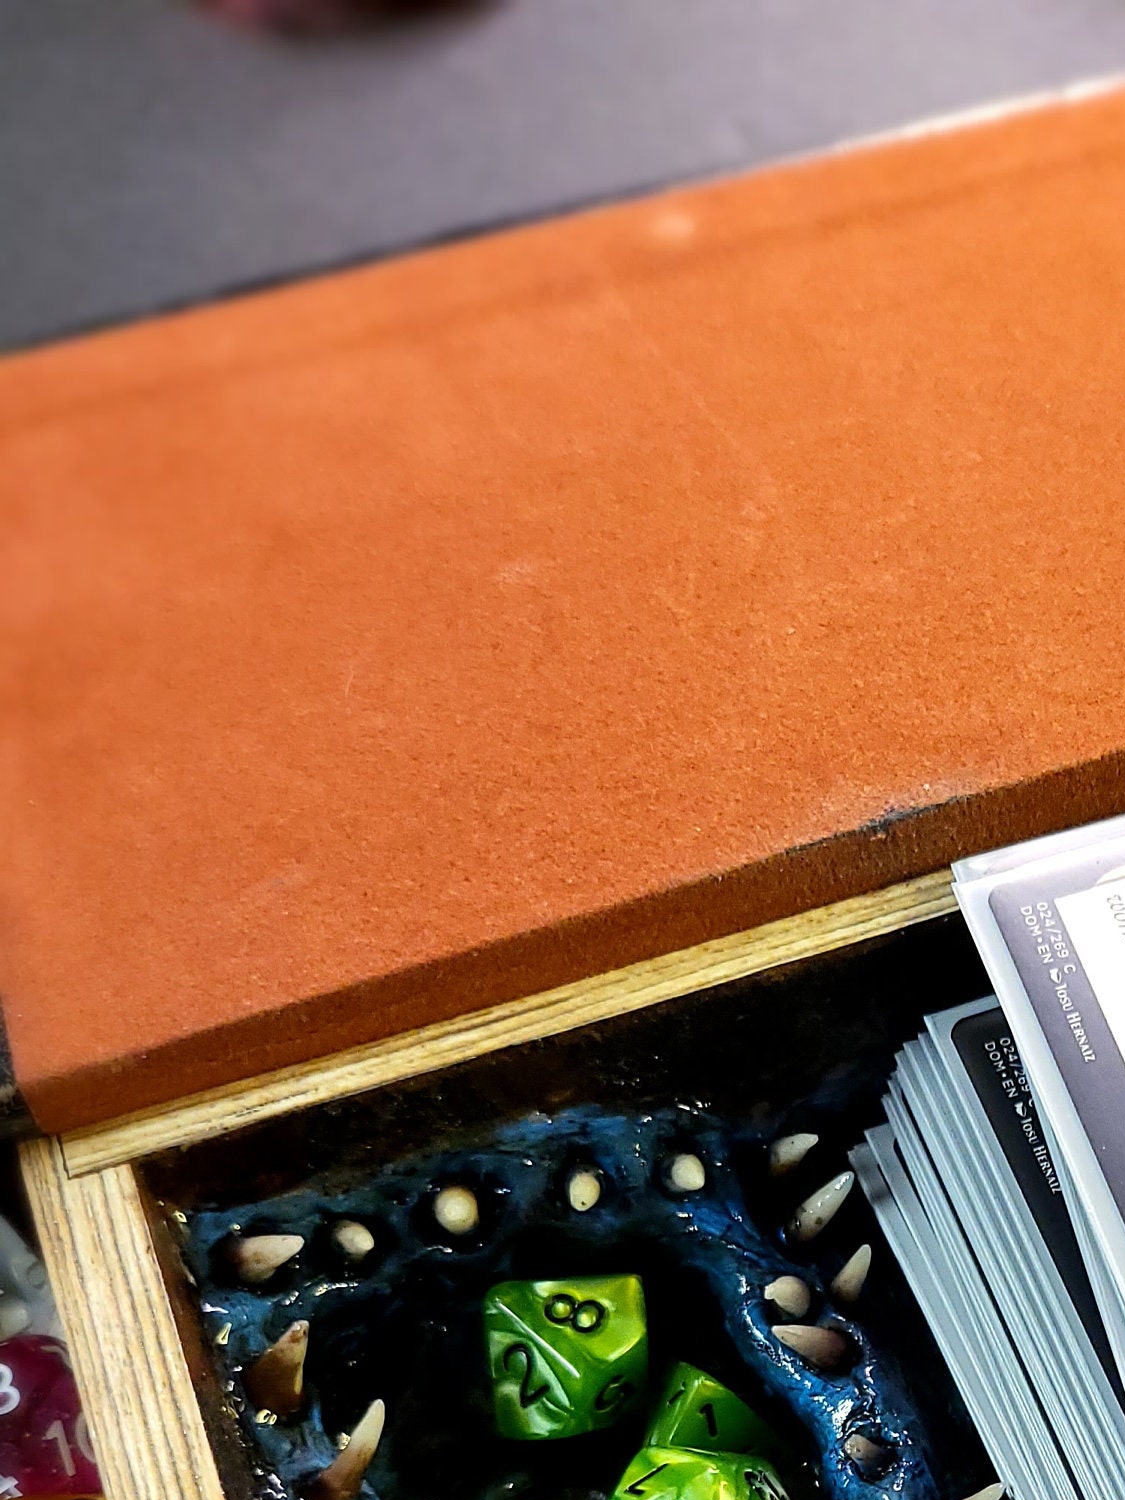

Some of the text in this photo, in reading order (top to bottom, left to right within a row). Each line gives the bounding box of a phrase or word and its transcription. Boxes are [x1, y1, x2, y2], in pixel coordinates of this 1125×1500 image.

[1035, 901, 1077, 975] 024/269 C
[1066, 1011, 1097, 1064] HERNAIZ
[1032, 1143, 1062, 1196] HERNAIZ
[544, 1293, 606, 1334] 8
[502, 1341, 552, 1409] 2
[699, 1402, 719, 1439] 1
